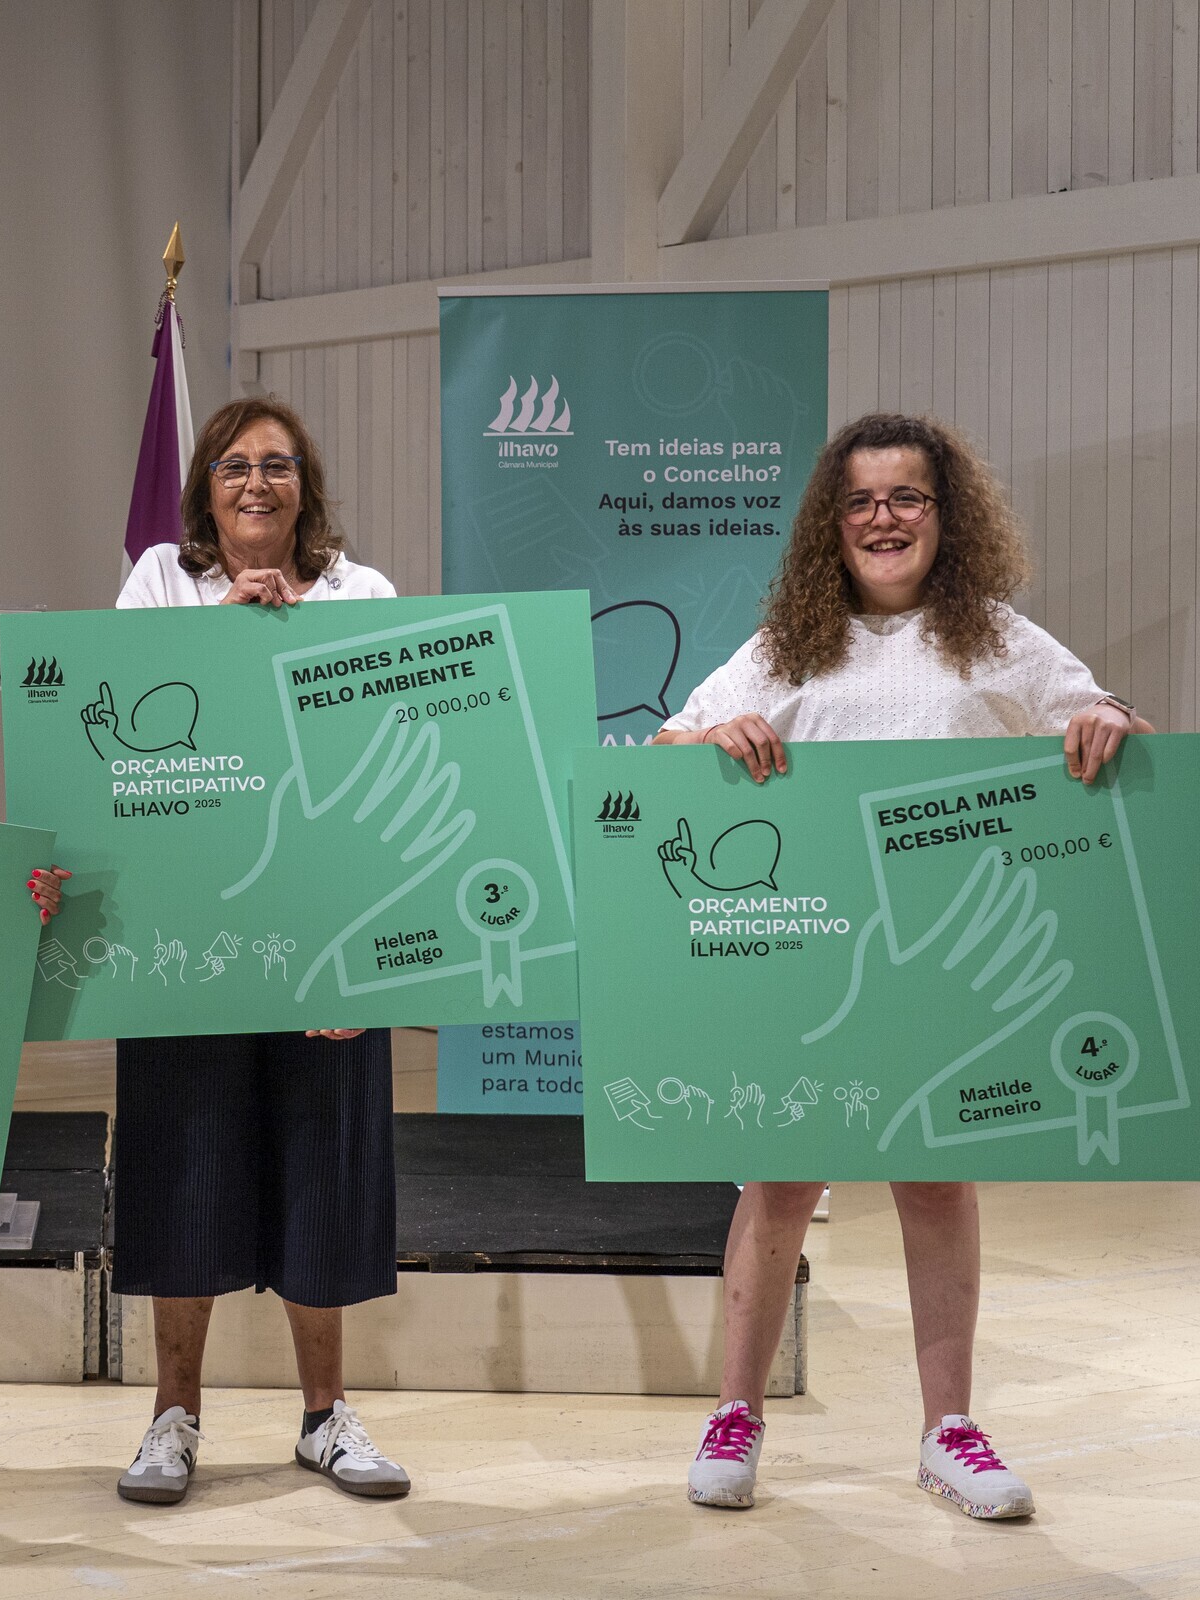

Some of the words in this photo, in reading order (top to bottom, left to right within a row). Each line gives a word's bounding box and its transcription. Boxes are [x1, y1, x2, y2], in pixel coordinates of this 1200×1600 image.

[604, 440, 651, 456] Tem
[659, 437, 724, 456] ideias
[732, 441, 782, 460] para
[498, 461, 525, 469] Câmara
[526, 461, 559, 469] Municipal
[643, 469, 656, 483] o
[663, 464, 781, 483] Concelho?
[598, 492, 654, 514] Aqui,
[661, 491, 736, 510] damos
[742, 495, 781, 509] voz
[618, 518, 643, 536] às
[650, 523, 701, 536] suas
[709, 518, 781, 536] ideias.
[291, 651, 395, 687] MAIORES
[399, 647, 414, 664] A
[417, 630, 495, 660] RODAR
[296, 689, 356, 713] PELO
[359, 659, 478, 701] AMBIENTE
[395, 706, 419, 724] 20
[426, 691, 491, 717] 000,00
[497, 687, 512, 702] €
[111, 755, 244, 779] ORÇAMENTO
[112, 775, 266, 797] PARTICIPATIVO
[113, 799, 190, 818] ÍLHAVO
[194, 798, 222, 809] 2025
[877, 795, 972, 827] ESCOLA
[976, 783, 1037, 809] MAIS
[883, 816, 1014, 855] ACESSÍVEL
[1001, 851, 1013, 866] 3
[1020, 837, 1090, 863] 000,00
[1097, 832, 1113, 849] €
[479, 907, 521, 926] LUGAR
[688, 896, 828, 918] ORÇAMENTO
[690, 918, 850, 936] PARTICIPATIVO
[373, 928, 440, 953] Helena
[690, 938, 770, 957] ÍLHAVO
[774, 940, 803, 950] 2025
[376, 947, 443, 971] Fidalgo
[481, 1023, 574, 1041] estamos
[482, 1052, 515, 1065] um
[1075, 1062, 1120, 1081] LUGAR
[482, 1078, 529, 1095] para
[958, 1078, 1034, 1105] Matilde
[958, 1099, 1042, 1123] Carneiro
